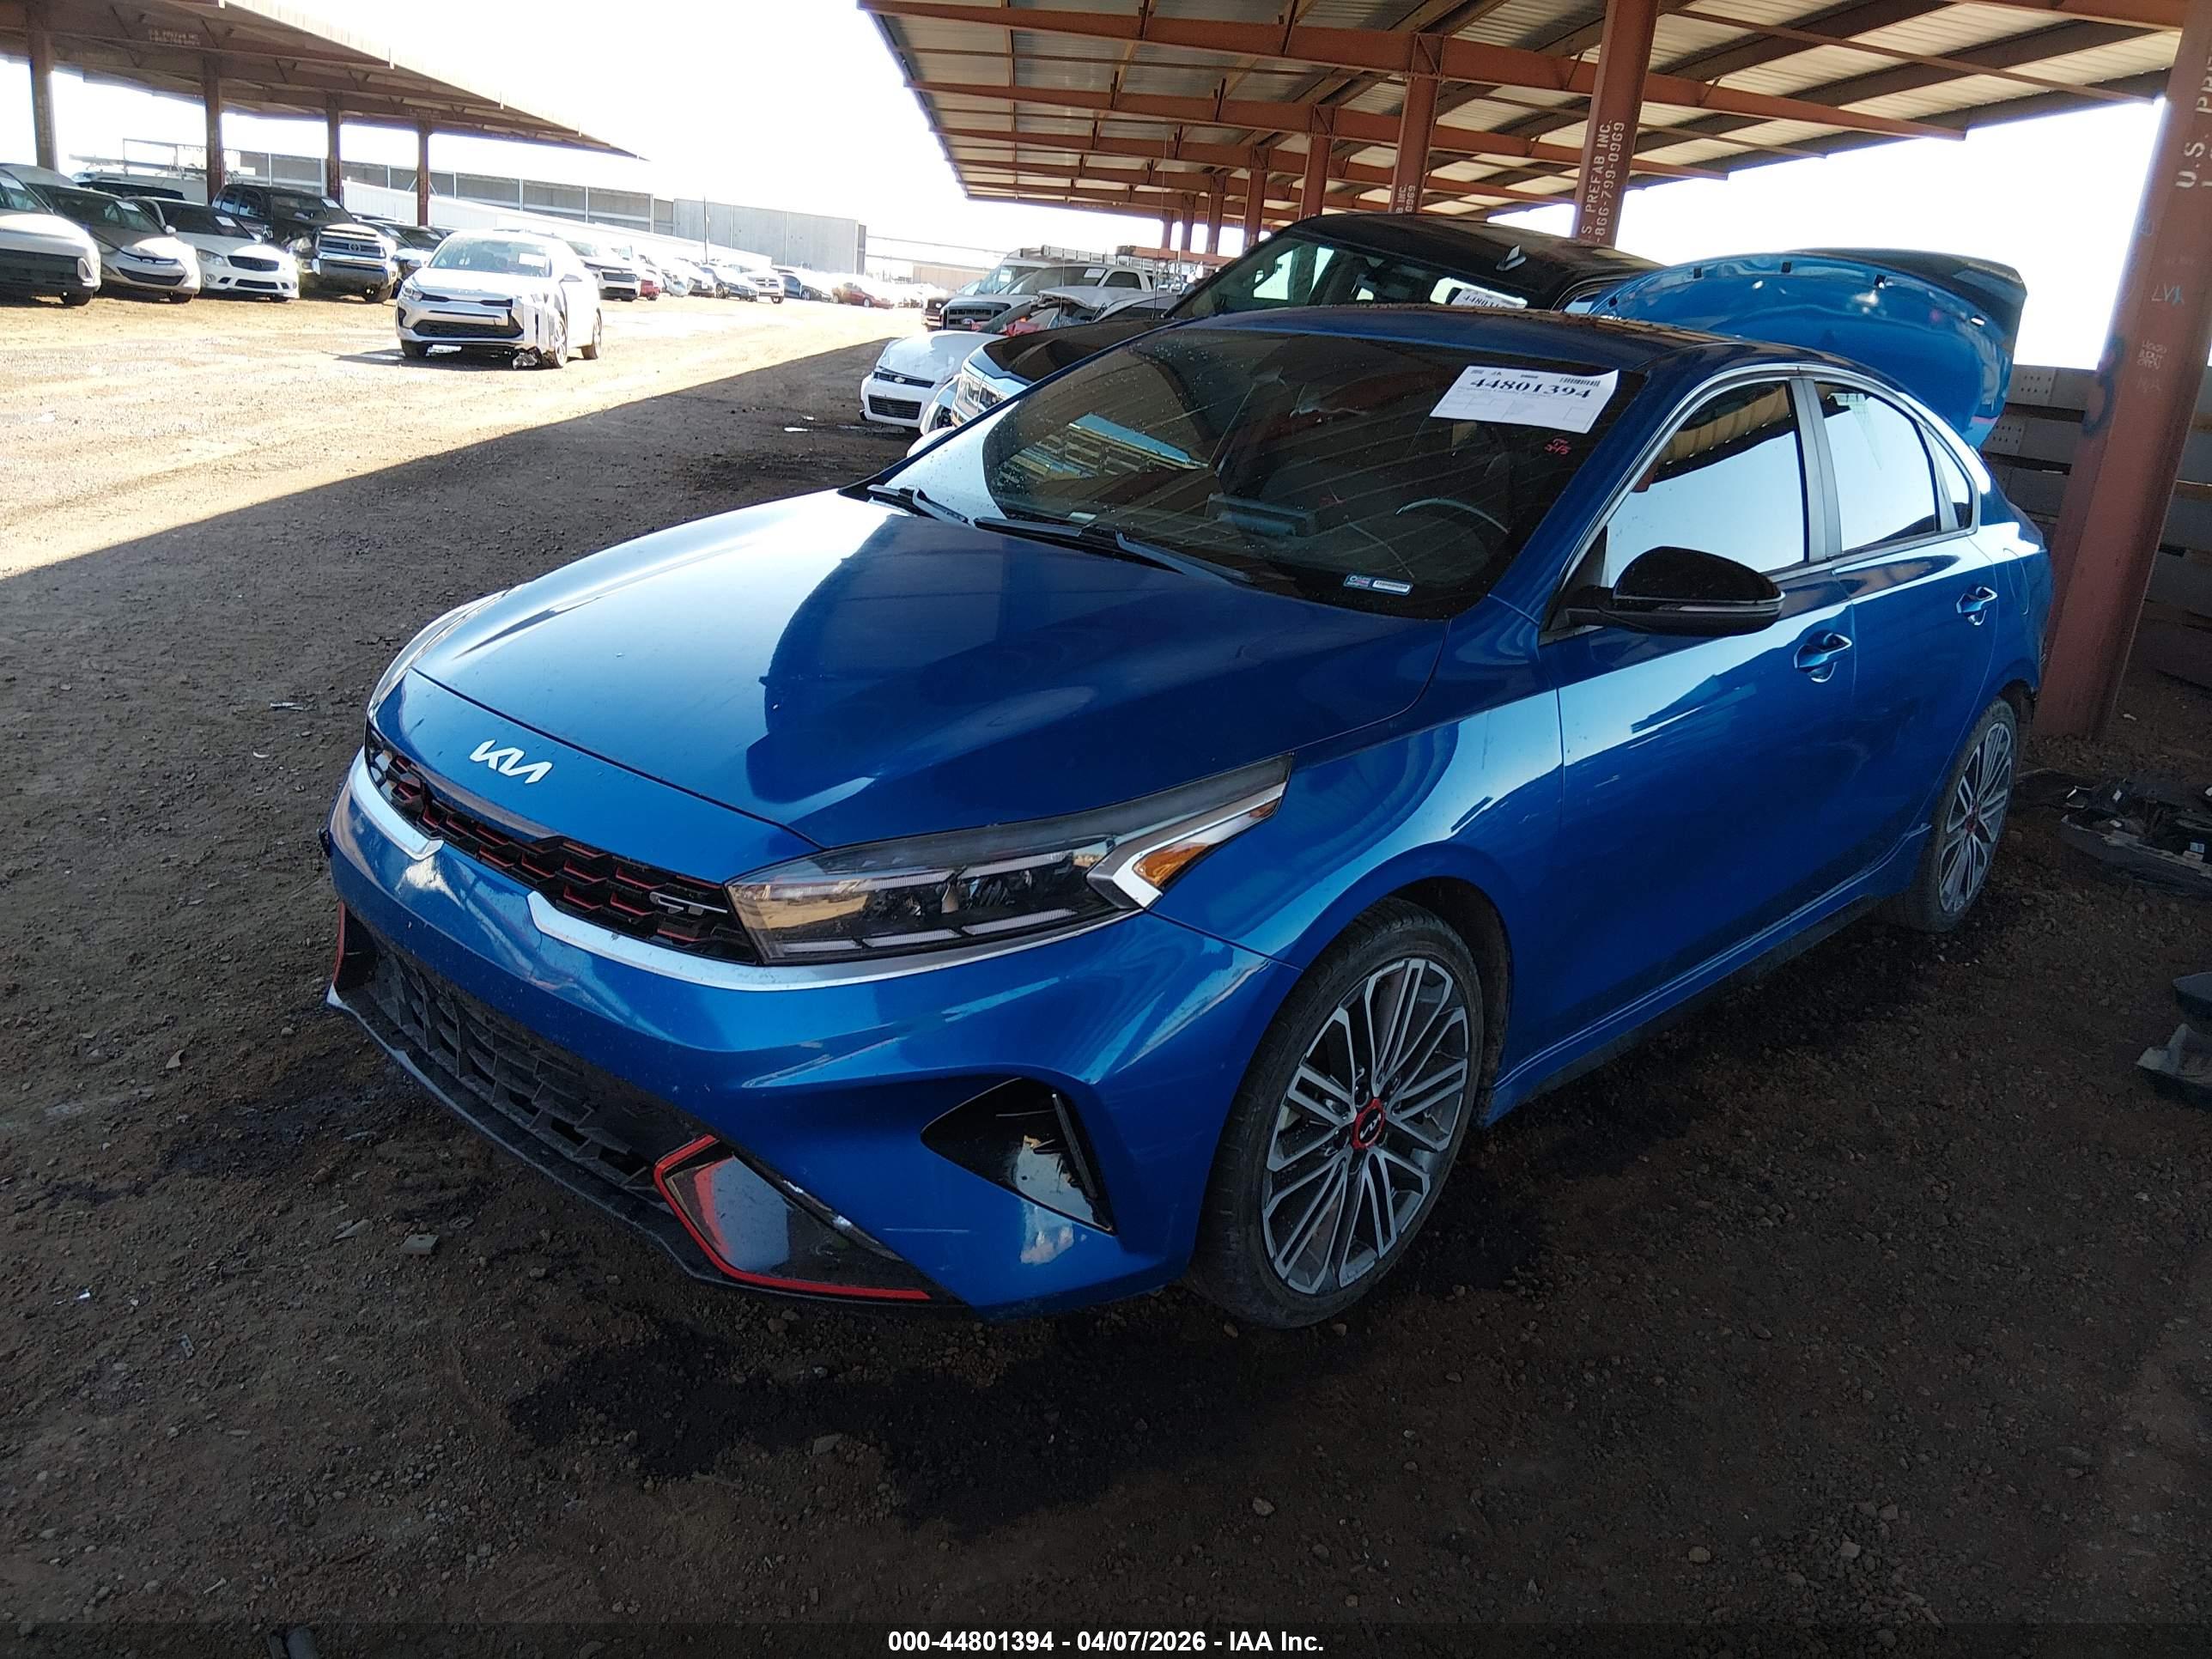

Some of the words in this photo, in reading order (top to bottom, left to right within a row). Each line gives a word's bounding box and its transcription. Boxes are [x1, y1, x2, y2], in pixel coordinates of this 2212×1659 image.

[1585, 155, 1606, 214] PREFAB
[1596, 119, 1613, 148] INC.
[2175, 133, 2209, 188] U.S.
[1470, 378, 1592, 399] 44801394
[469, 739, 553, 784] KIA
[649, 891, 728, 916] GT
